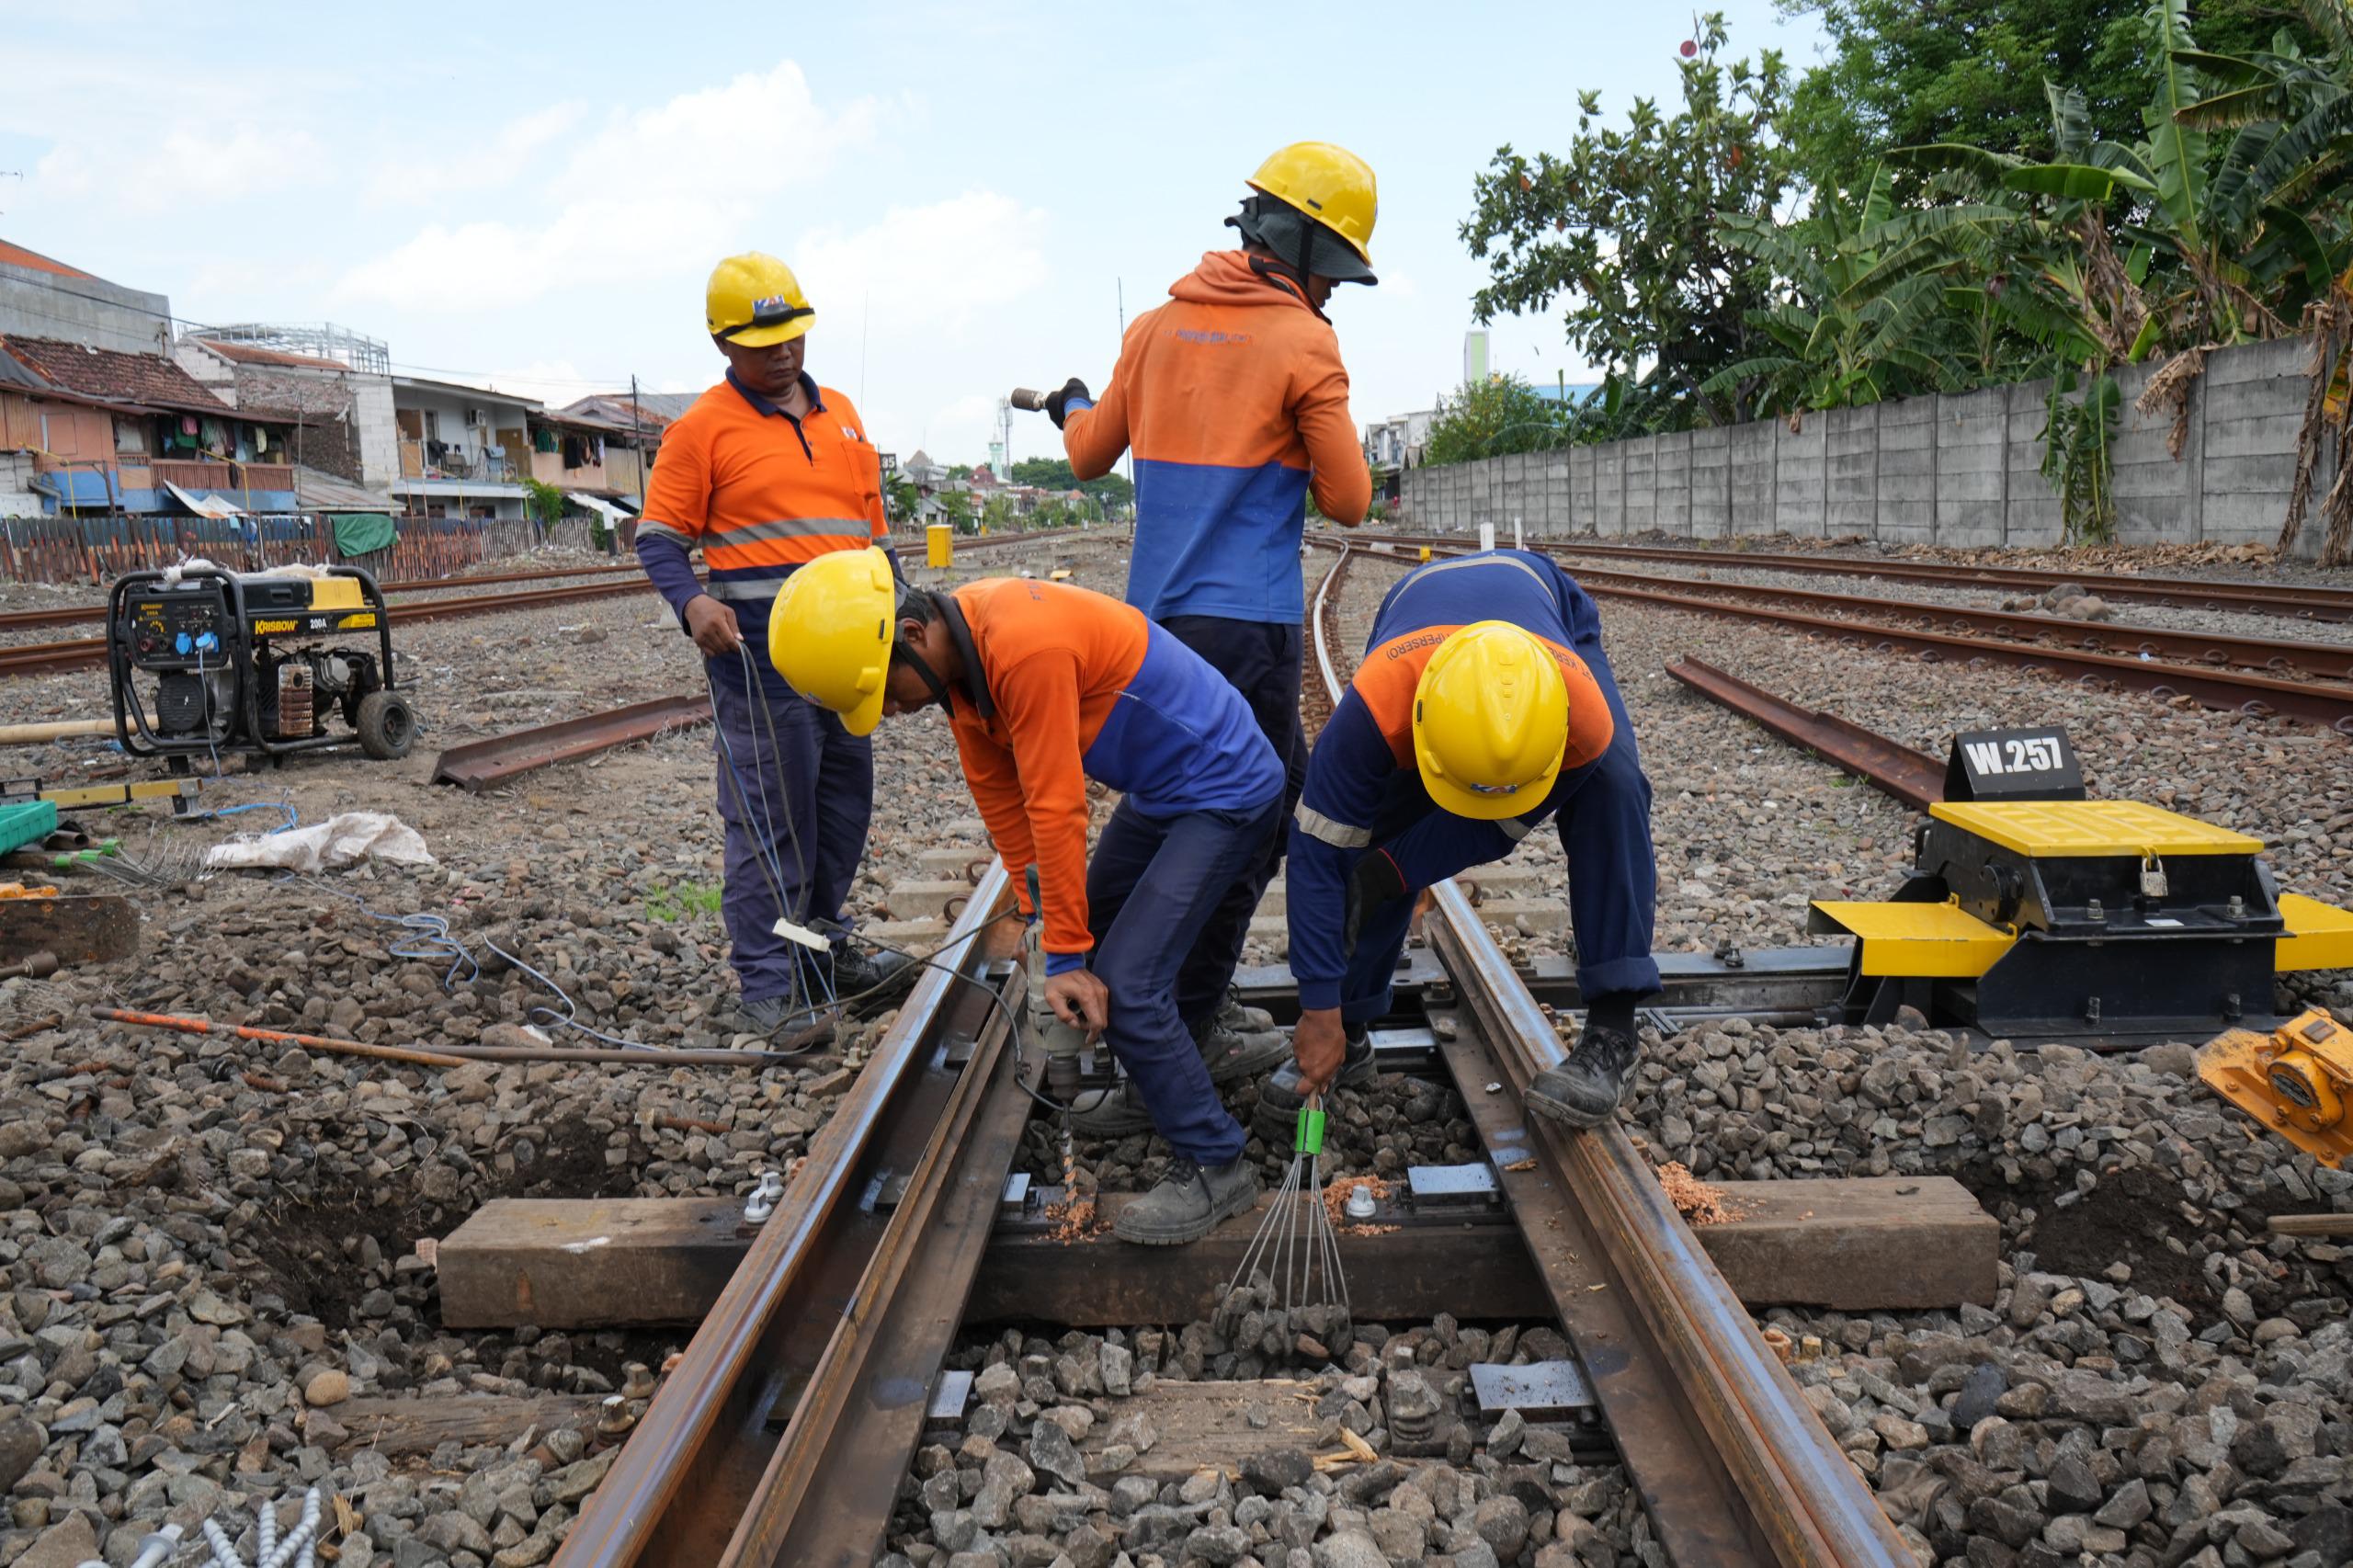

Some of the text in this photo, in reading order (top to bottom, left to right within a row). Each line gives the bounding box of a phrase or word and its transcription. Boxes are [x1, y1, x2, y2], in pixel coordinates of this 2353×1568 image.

[255, 619, 296, 635] KRISBOW
[310, 618, 327, 630] 200A
[1964, 736, 2063, 776] W.257
